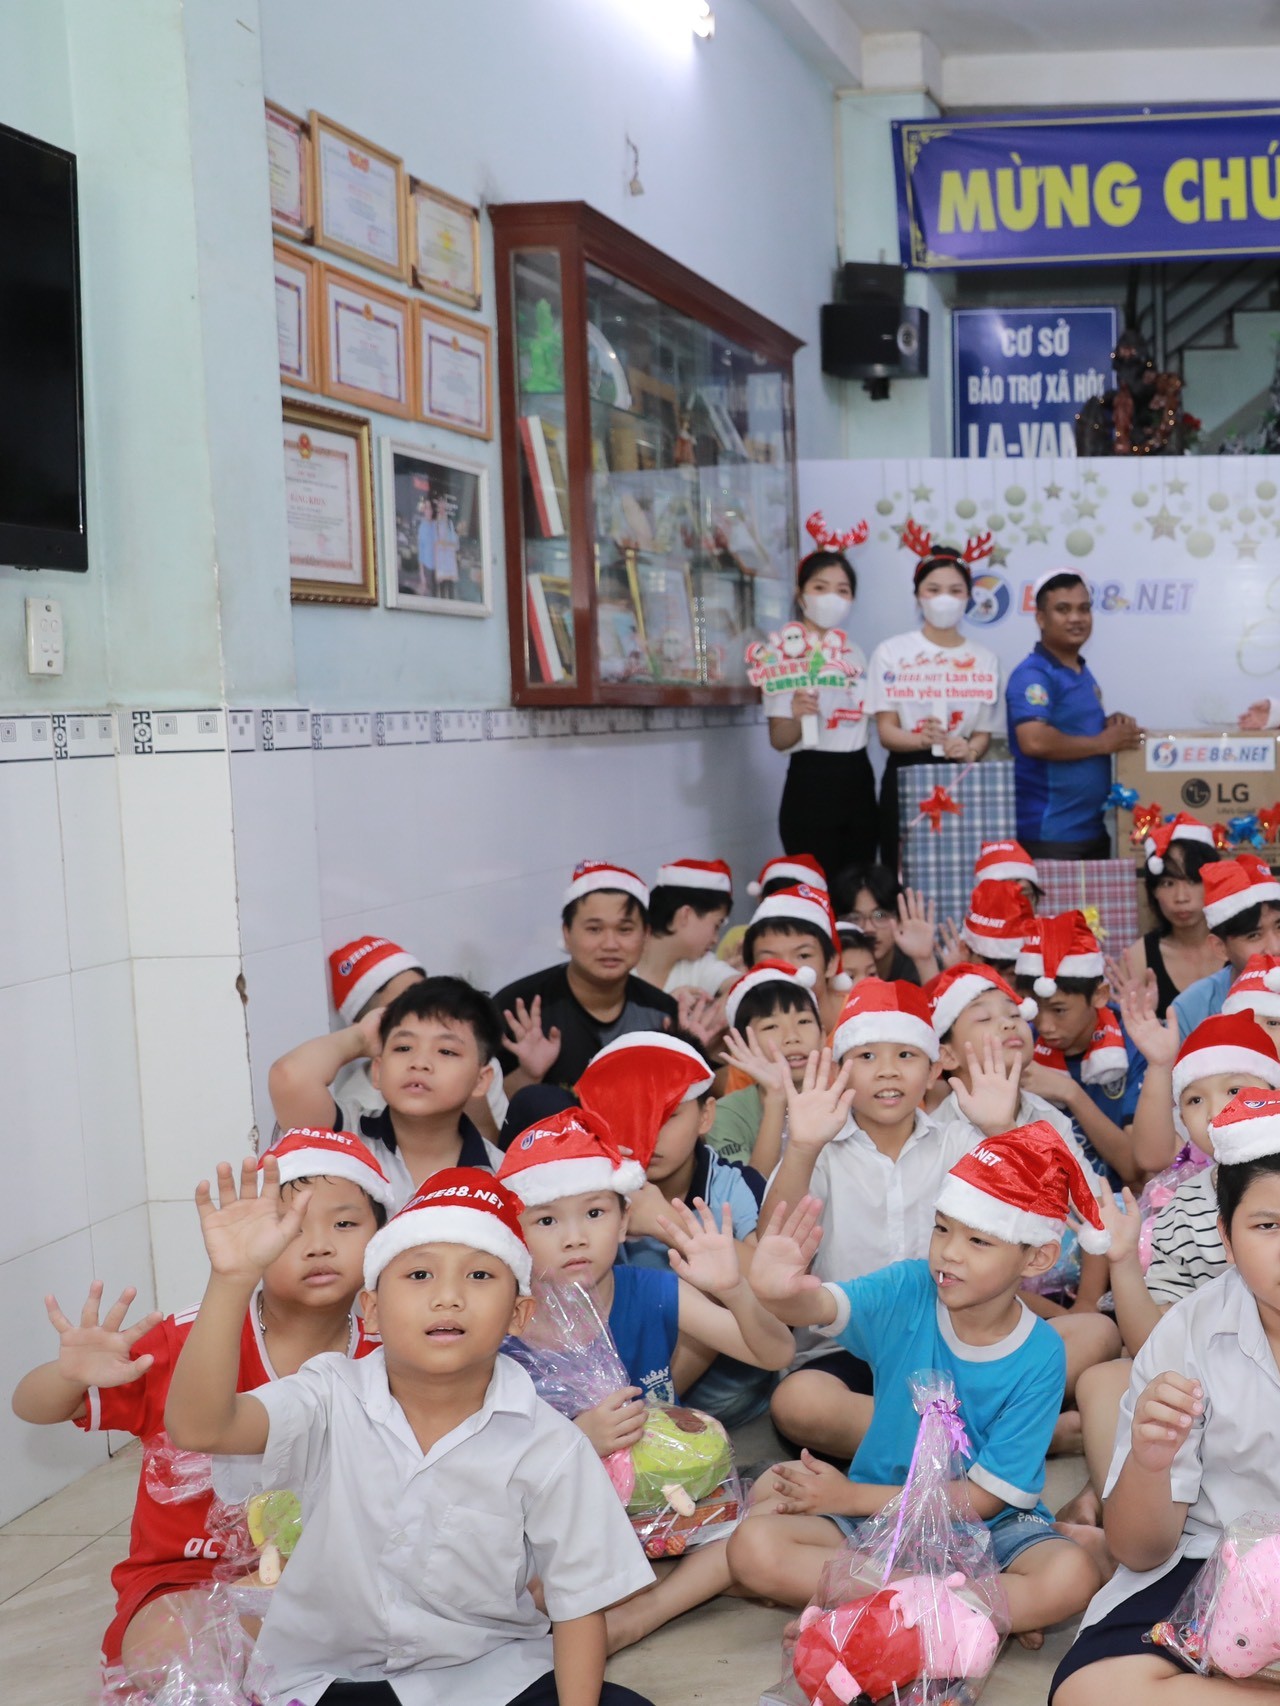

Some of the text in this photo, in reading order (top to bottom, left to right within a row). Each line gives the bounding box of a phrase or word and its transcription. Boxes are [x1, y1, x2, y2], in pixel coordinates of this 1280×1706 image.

[937, 151, 1141, 234] MỪNG
[1001, 318, 1070, 357] CƠ SỞ
[968, 366, 1004, 405] BẢO
[1007, 371, 1042, 409] TRỢ
[1045, 368, 1071, 403] XÃ
[1183, 746, 1269, 762] EE88.NET
[1217, 783, 1249, 803] LG
[424, 1185, 504, 1210] EE88.NET
